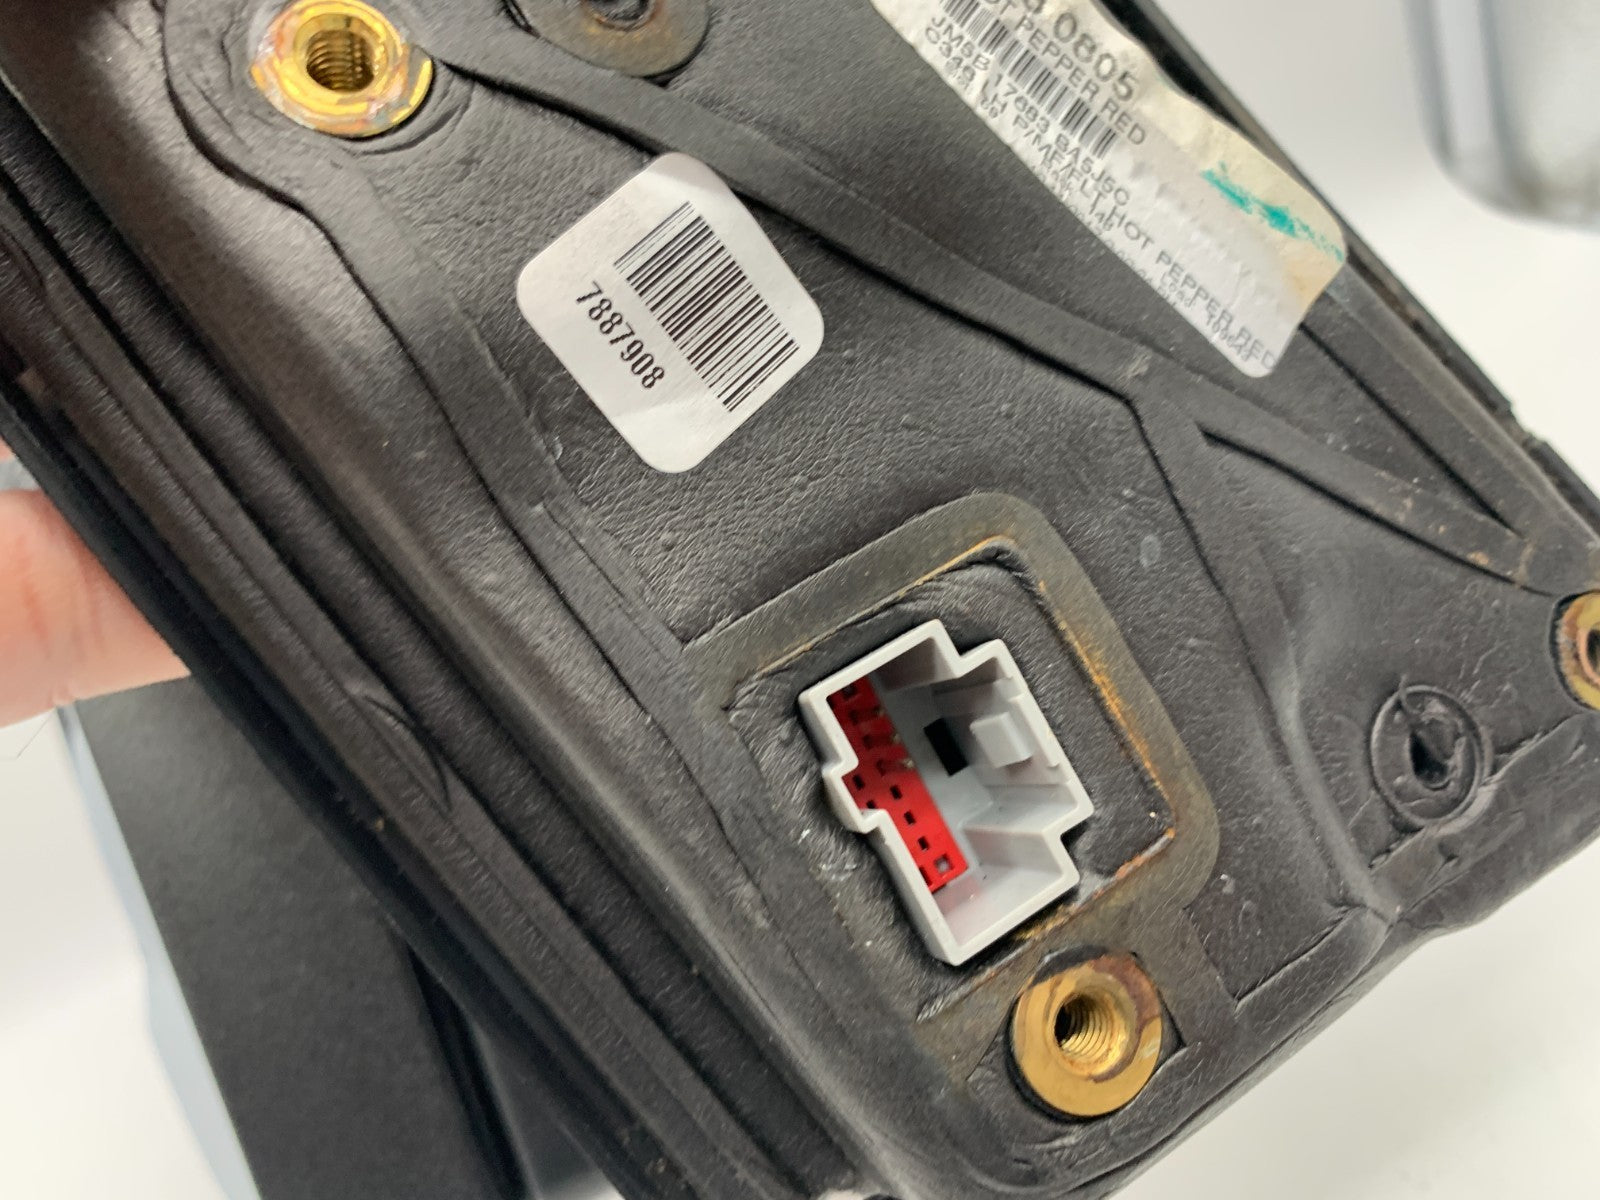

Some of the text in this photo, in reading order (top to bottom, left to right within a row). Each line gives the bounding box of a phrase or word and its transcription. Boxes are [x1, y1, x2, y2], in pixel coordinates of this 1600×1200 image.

[1014, 15, 1100, 102] PEPPER
[1103, 100, 1146, 145] RED
[1053, 12, 1138, 101] 0805
[576, 280, 665, 389] 7887908
[1107, 205, 1155, 250] HOT
[1155, 250, 1235, 331] PEPPER
[1235, 325, 1277, 369] RED
